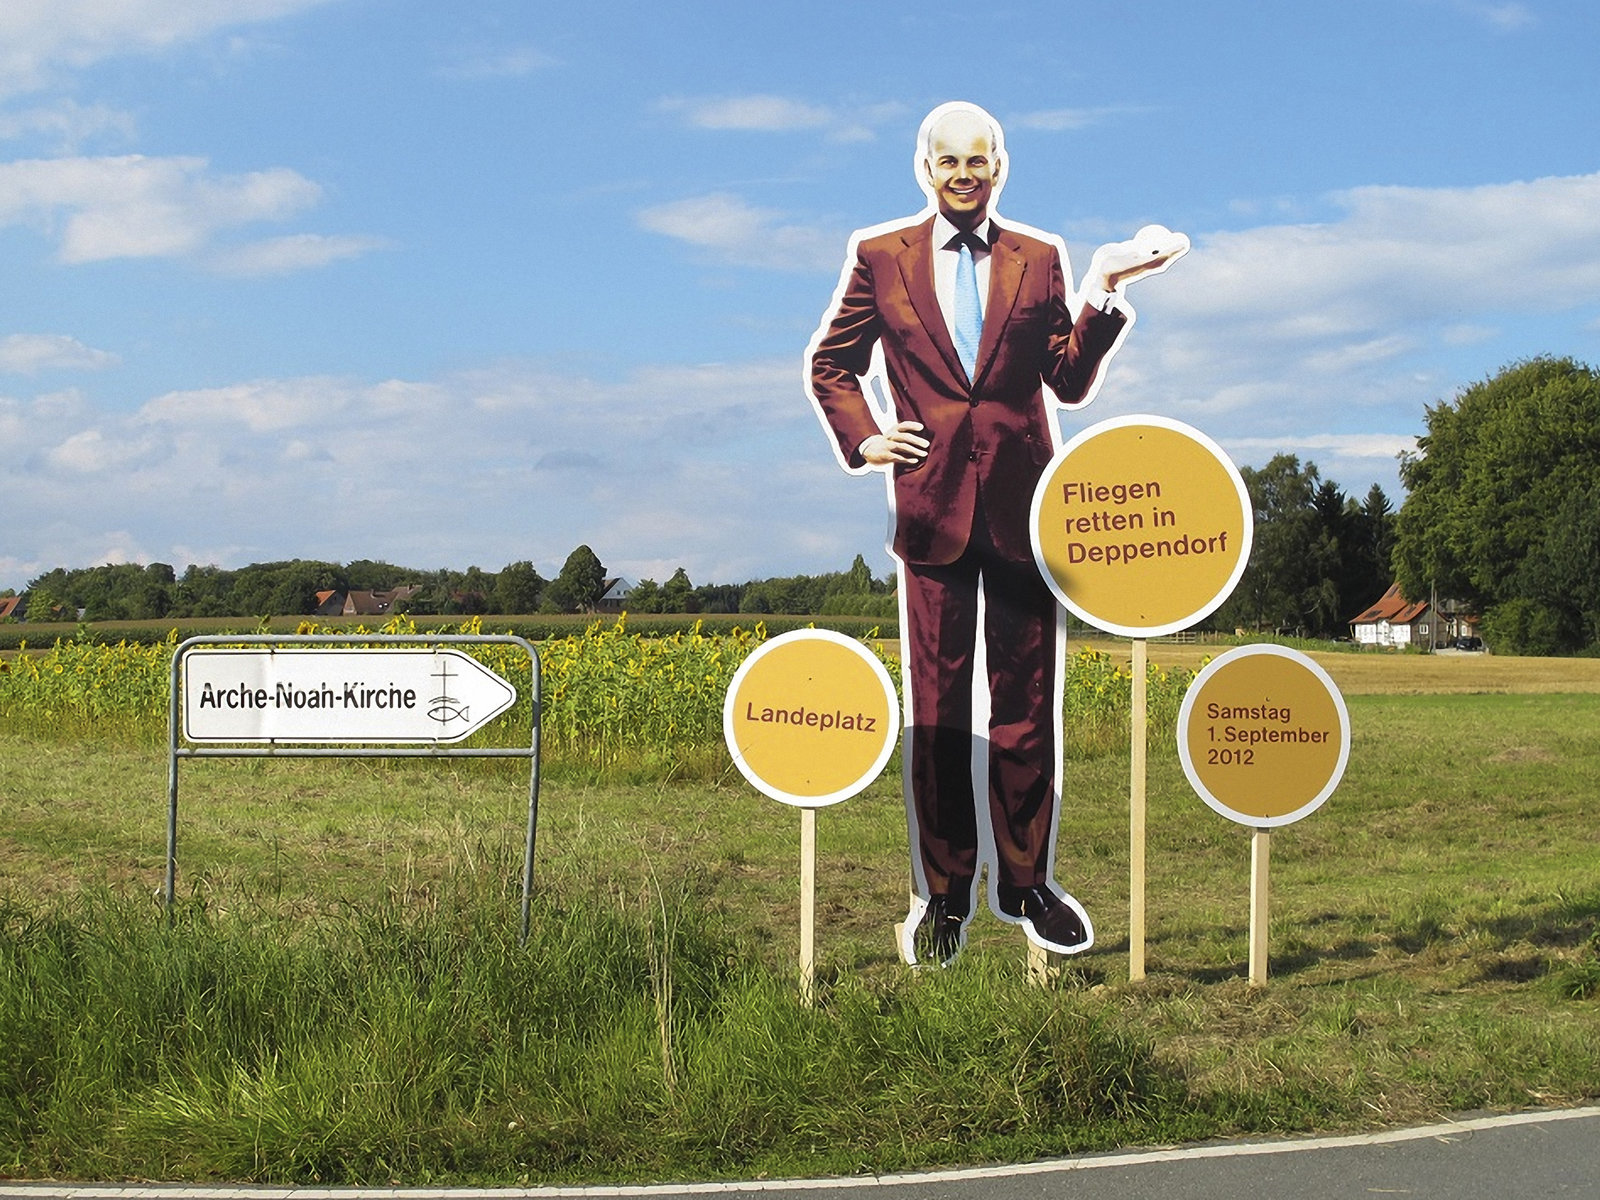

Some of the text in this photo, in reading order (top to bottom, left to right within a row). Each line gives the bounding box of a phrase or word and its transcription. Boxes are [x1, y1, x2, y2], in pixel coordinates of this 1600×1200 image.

[1062, 481, 1161, 505] Fliegen
[1065, 506, 1176, 535] retten in
[1067, 531, 1228, 566] Deppendorf
[199, 681, 417, 709] Arche-Noah-Kirche
[746, 702, 876, 733] Landeplatz
[1207, 702, 1291, 724] Samstag
[1207, 748, 1255, 765] 2012
